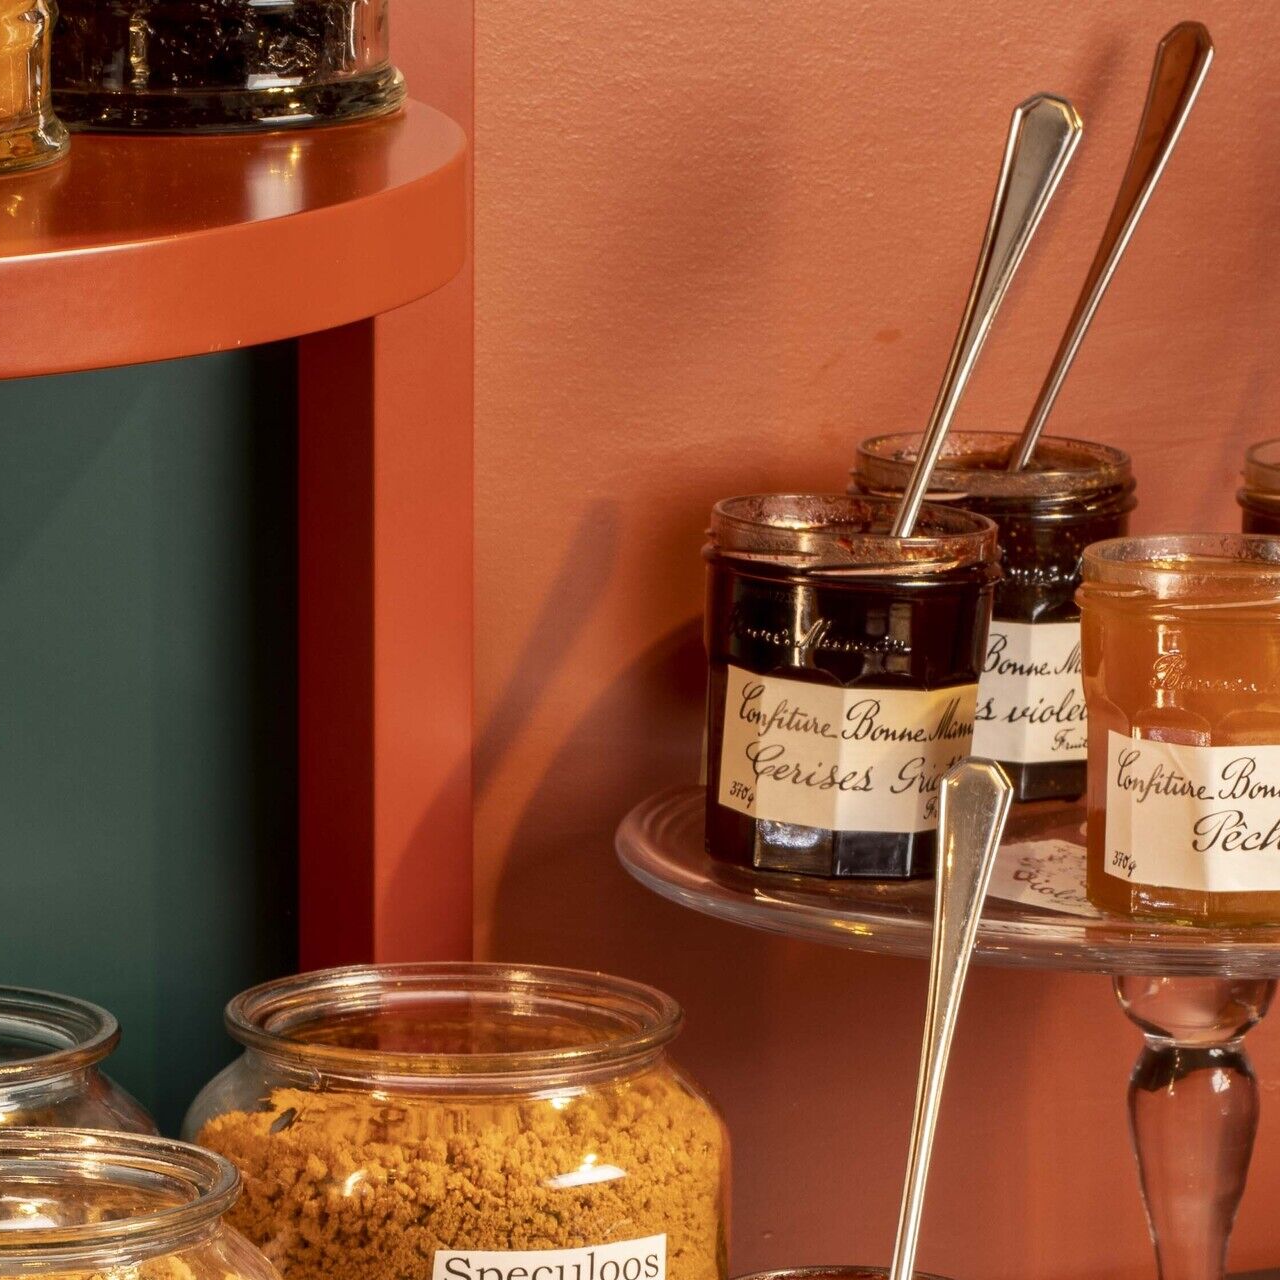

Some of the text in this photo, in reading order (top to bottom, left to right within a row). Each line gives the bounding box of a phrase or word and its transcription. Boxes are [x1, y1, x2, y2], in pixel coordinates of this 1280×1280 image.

[982, 633, 1051, 676] Bonne
[739, 681, 839, 736] Confiture
[841, 698, 927, 742] Bonne
[928, 696, 974, 742] Mam
[745, 741, 874, 792] Cerises
[1117, 748, 1214, 803] Confiture
